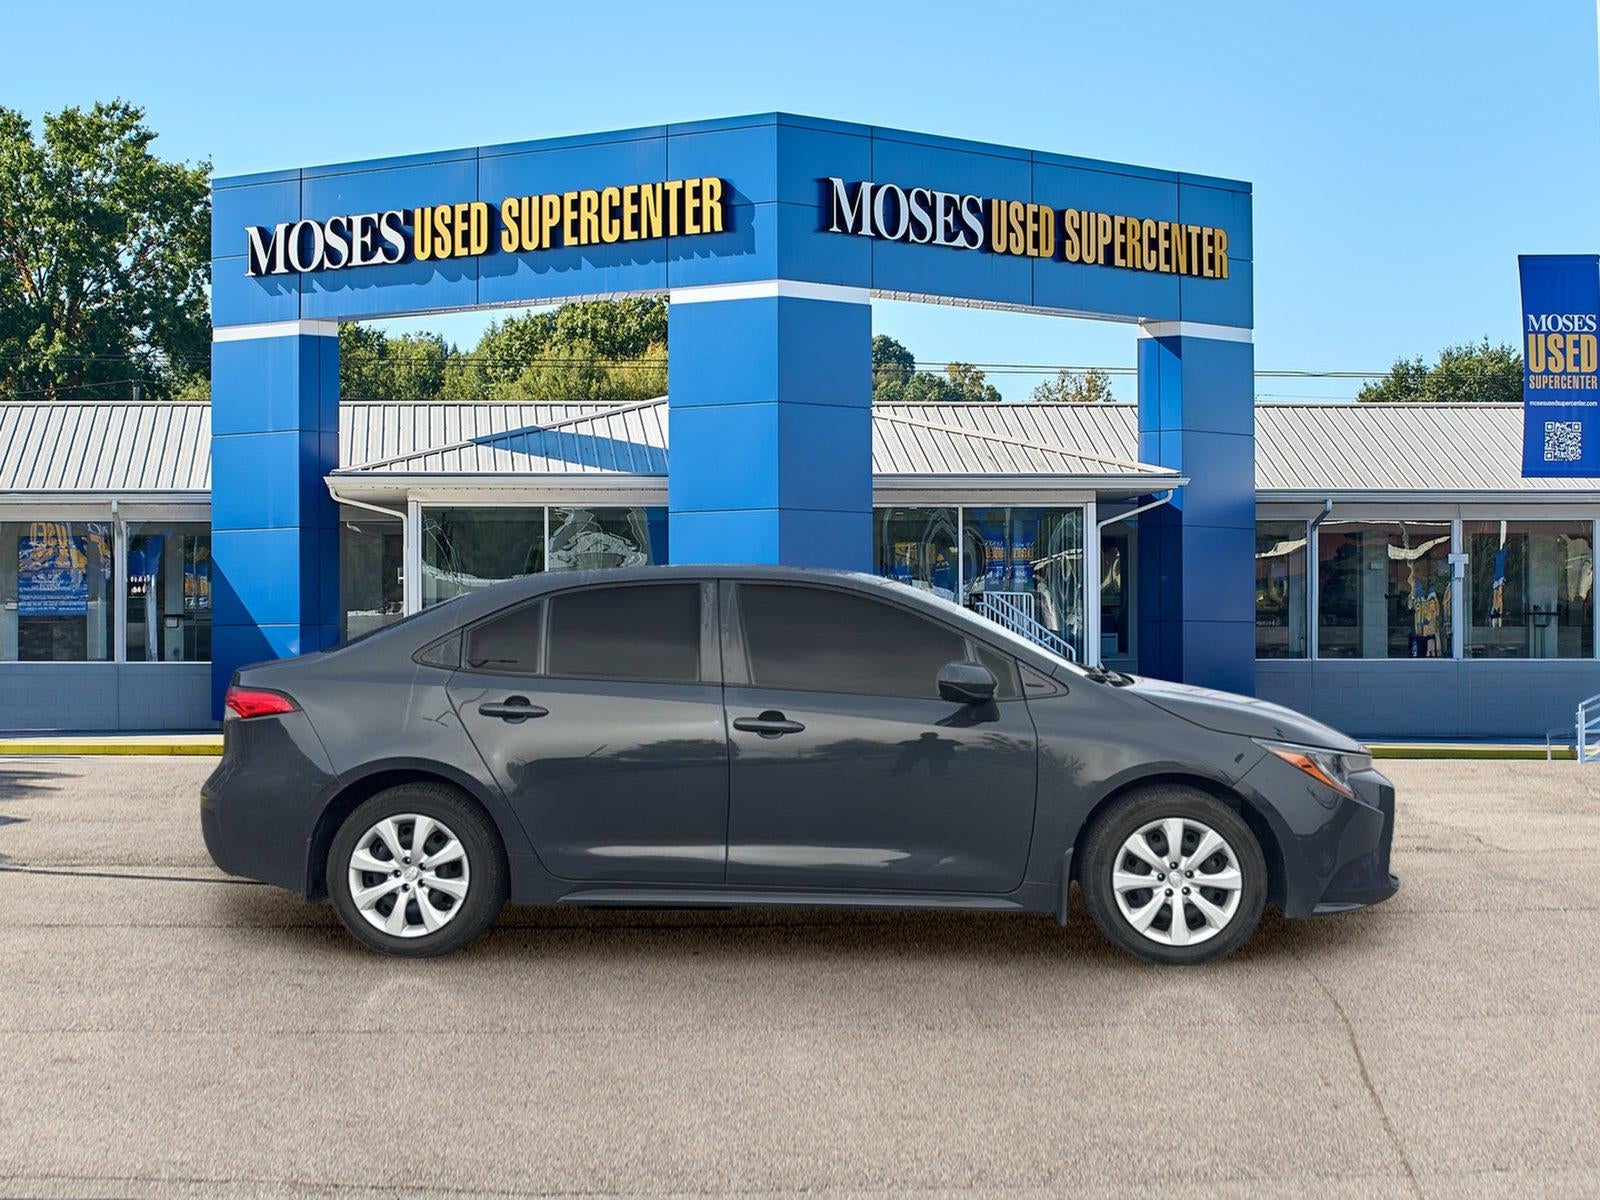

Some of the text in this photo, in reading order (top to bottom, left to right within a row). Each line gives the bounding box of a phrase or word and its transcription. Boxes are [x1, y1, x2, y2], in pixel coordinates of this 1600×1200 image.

[244, 176, 724, 277] MOSES USED SUPERCENTER
[829, 177, 1229, 279] MOSES USED SUPERCENTER
[1527, 313, 1597, 332] MOSES
[1528, 333, 1598, 373] USED
[1529, 375, 1598, 389] SUPERCENTER
